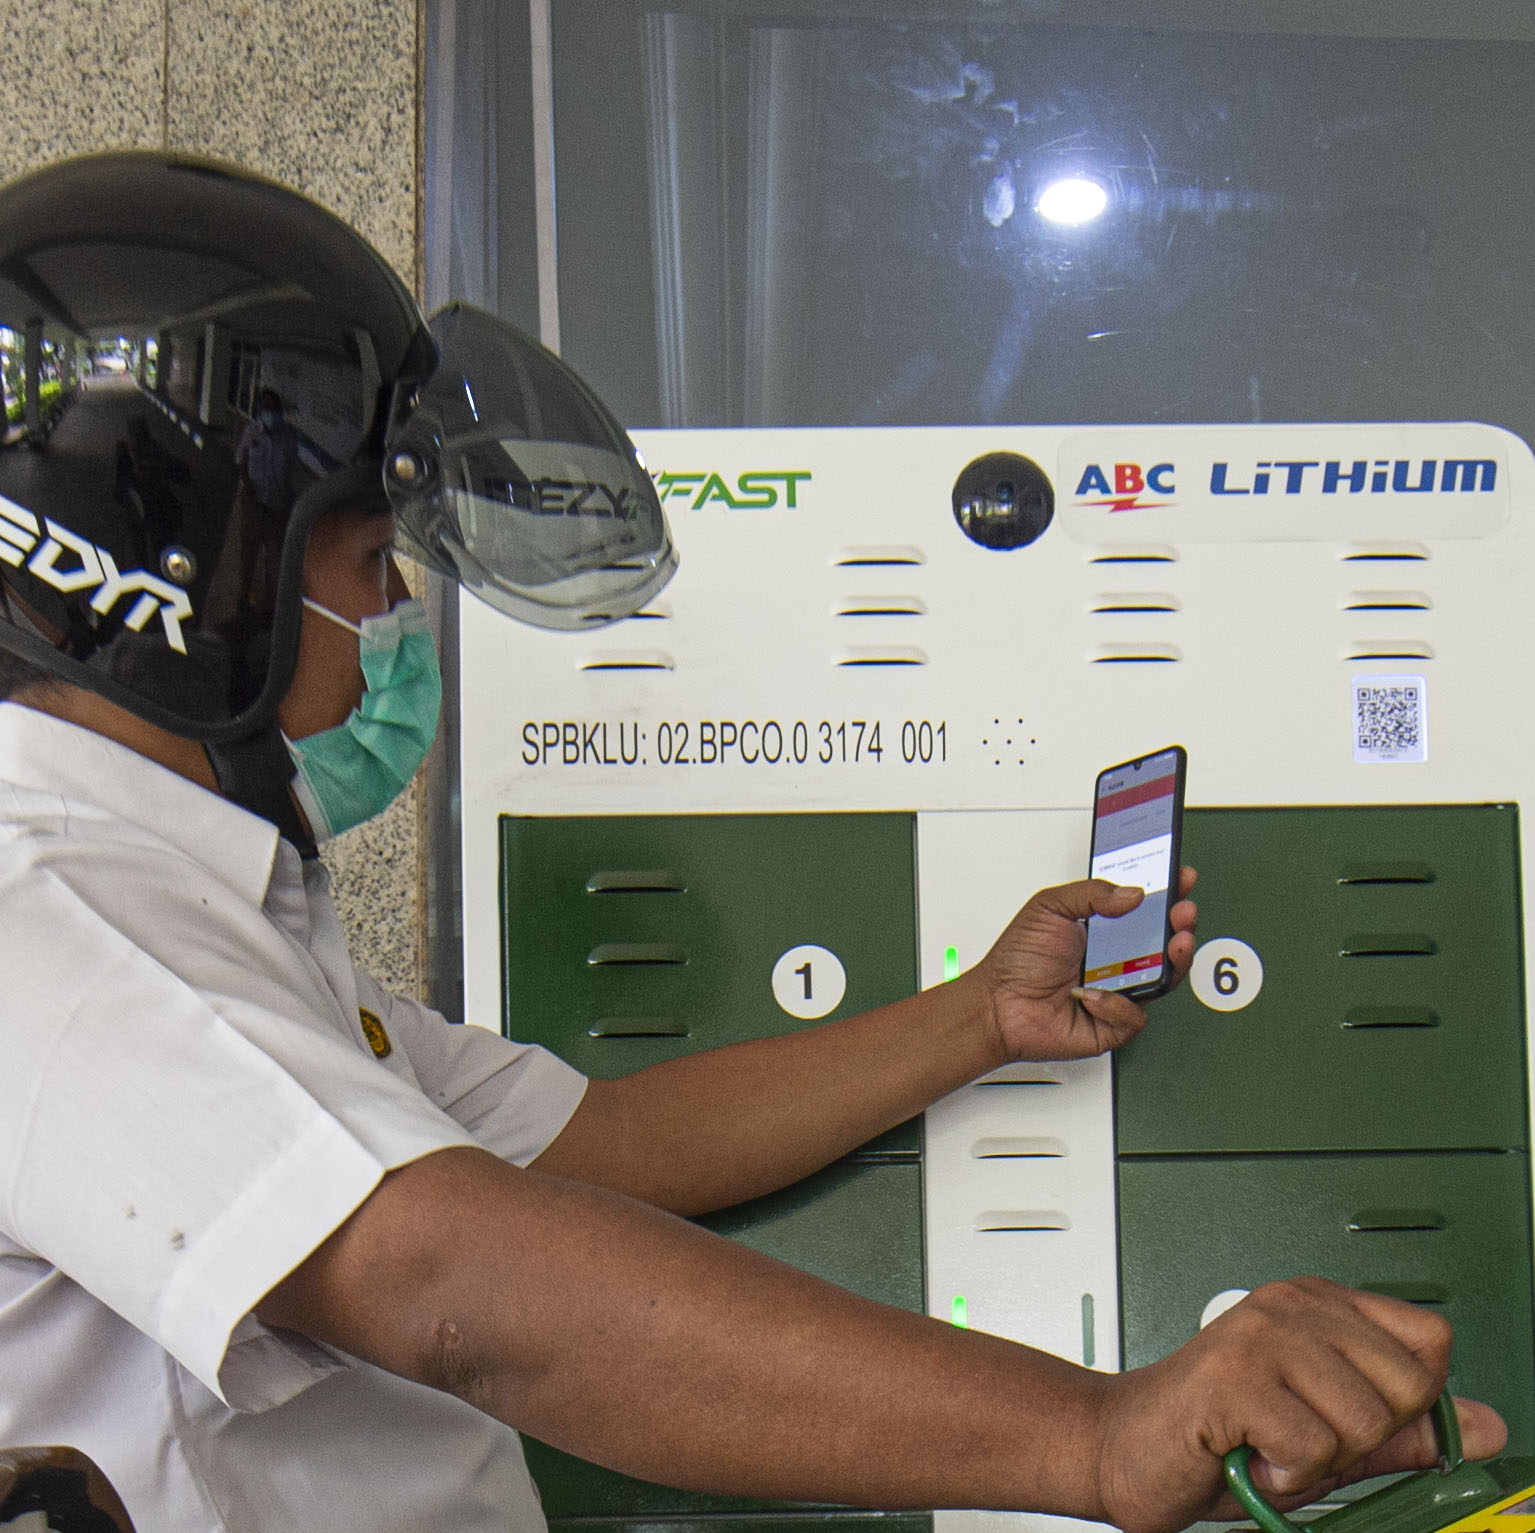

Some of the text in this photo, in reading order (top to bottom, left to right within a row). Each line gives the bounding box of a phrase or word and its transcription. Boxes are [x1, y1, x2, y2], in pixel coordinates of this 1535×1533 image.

[1075, 463, 1175, 495] ABC
[522, 721, 647, 765] SPBKLU:
[818, 720, 883, 764] 3174
[901, 720, 947, 763] 001
[795, 962, 812, 1000] 1
[1214, 957, 1239, 995] 6
